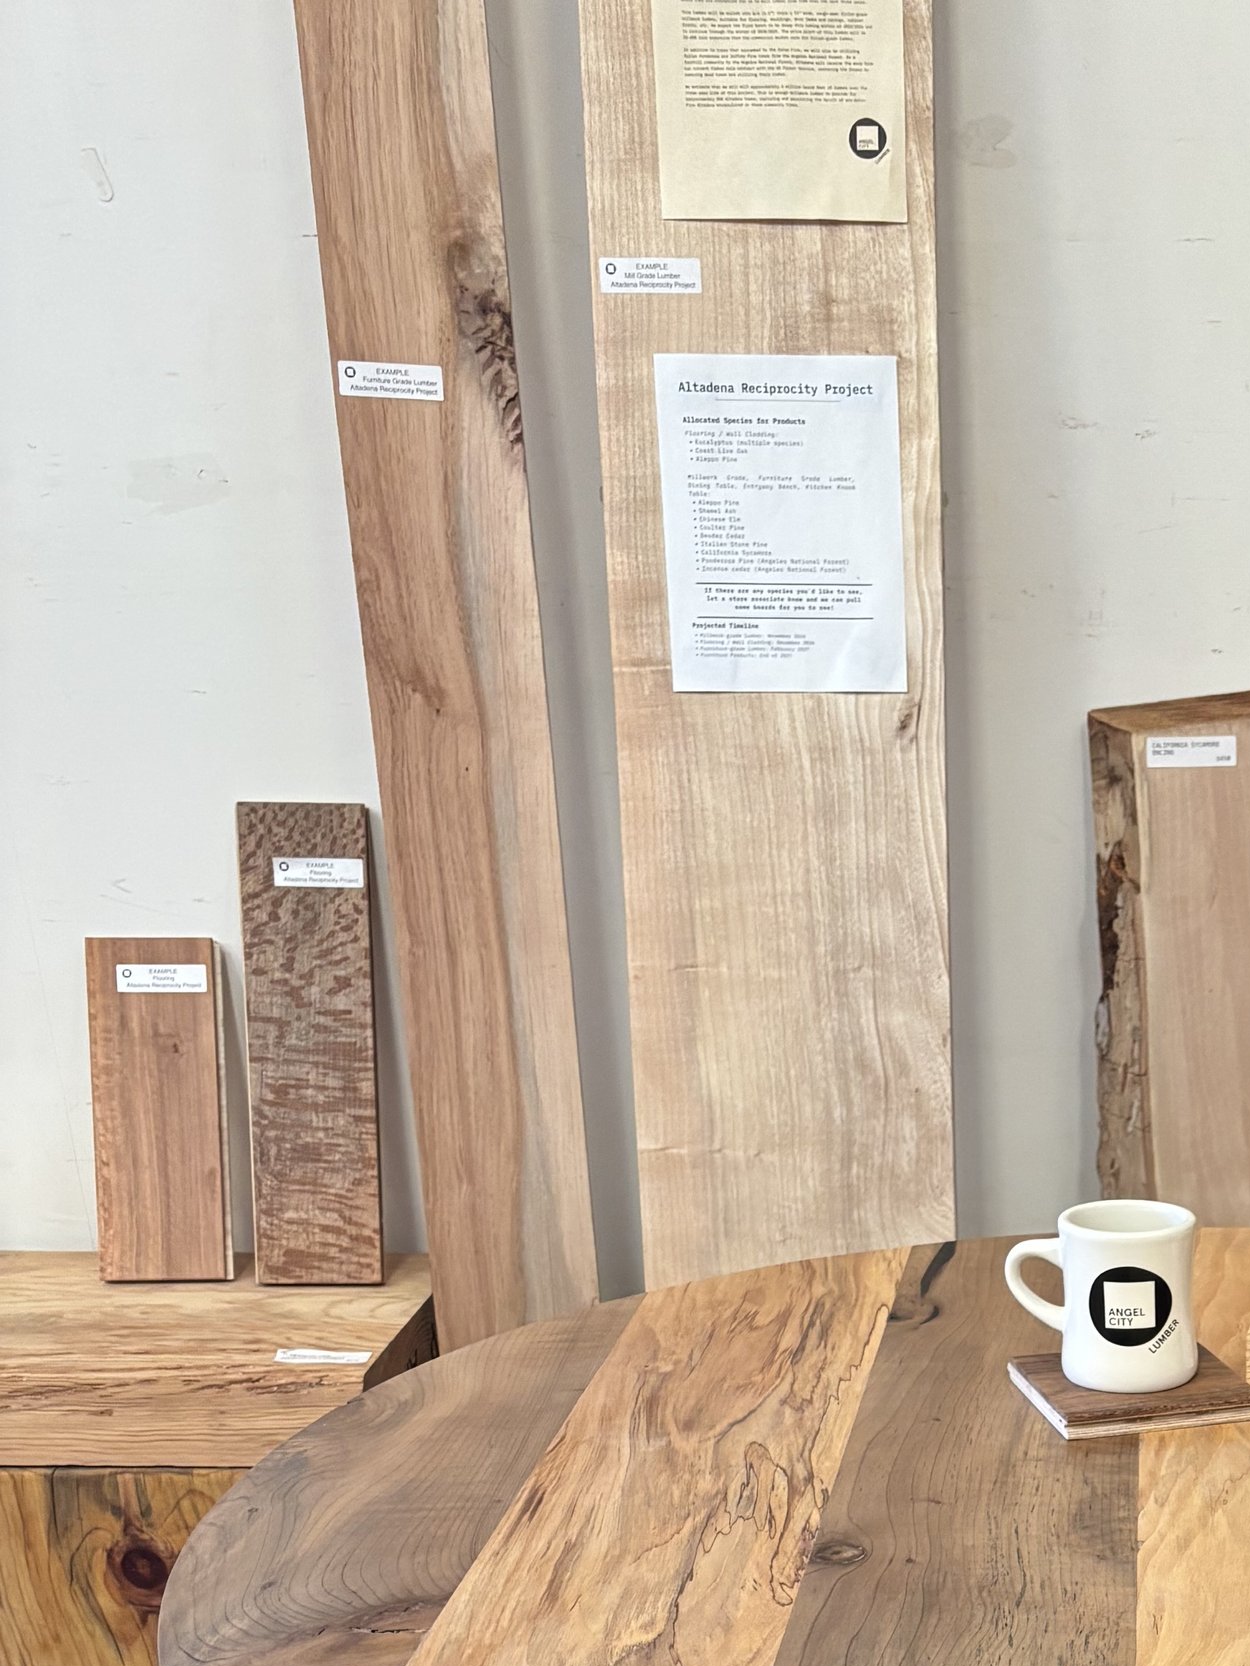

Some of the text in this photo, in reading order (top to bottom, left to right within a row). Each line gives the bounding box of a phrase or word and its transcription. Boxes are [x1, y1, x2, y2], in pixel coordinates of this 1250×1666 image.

[376, 368, 409, 376] EXAMPLE
[363, 376, 390, 384] Furniture
[380, 386, 414, 394] Reciprocity
[416, 388, 437, 396] Project
[678, 382, 873, 397] Altadena Reciprocity Project
[723, 417, 752, 425] Species
[1108, 1308, 1145, 1316] ANGEL
[1109, 1318, 1134, 1326] CITY
[1148, 1319, 1179, 1354] LUMBER
